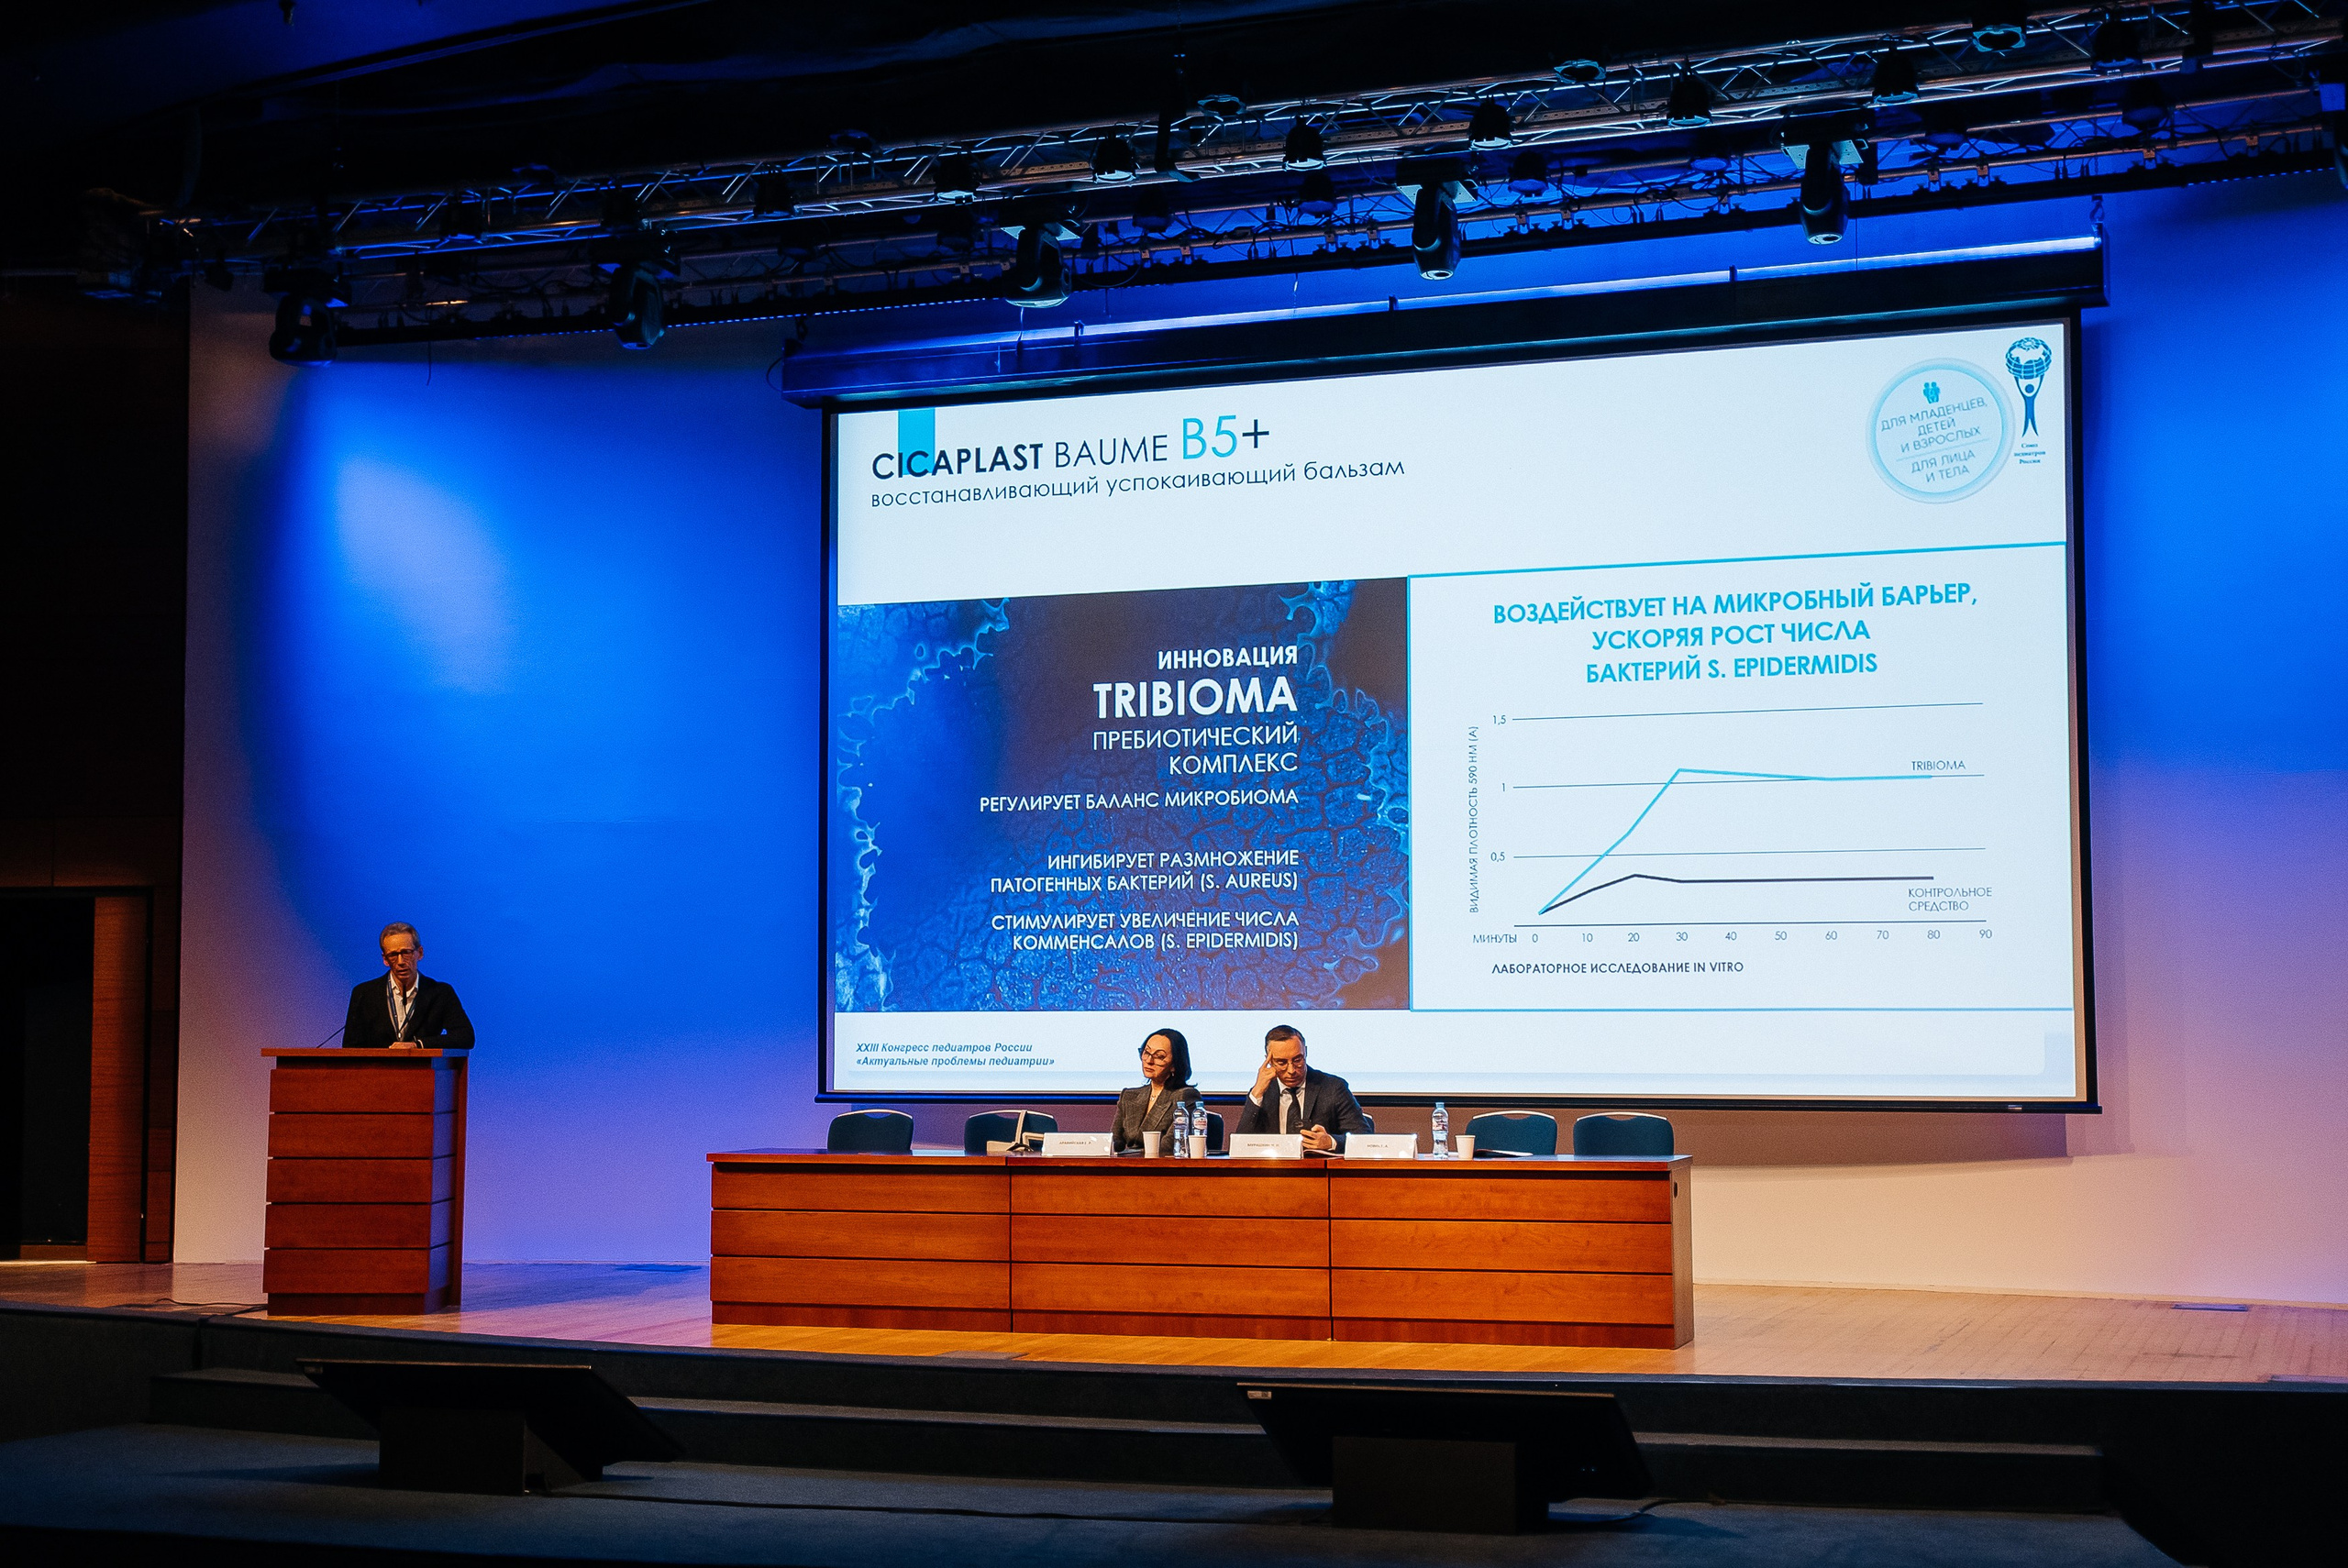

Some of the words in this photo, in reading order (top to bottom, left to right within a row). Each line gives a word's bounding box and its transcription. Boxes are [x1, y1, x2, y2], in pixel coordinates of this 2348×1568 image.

[1881, 415, 1907, 432] ДЛЯ
[1918, 418, 1956, 436] ДЕТЕЙ
[871, 444, 1043, 480] CICAPLAST
[1056, 435, 1167, 468] BAUME
[1183, 415, 1269, 459] B5+
[1901, 443, 1910, 453] И
[1914, 426, 1981, 450] ВЗРОСЛЫХ
[1911, 458, 1938, 473] ДЛЯ
[1942, 449, 1976, 468] ЛИЦА
[871, 476, 1100, 508] восстанавливающий
[1106, 463, 1296, 497] успокаивающий
[1303, 458, 1405, 480] бальзам
[1926, 472, 1935, 482] И
[1940, 465, 1970, 480] ТЕЛА
[1494, 596, 1666, 624] ВОЗДЕЙСТВУЕТ
[1673, 596, 1706, 615] НА
[1713, 582, 1873, 613] МИКРОБНЫЙ
[1882, 582, 1978, 609] БАРЬЕР,
[1592, 627, 1702, 650] УСКОРЯЯ
[1711, 624, 1775, 645] РОСТ
[1781, 620, 1870, 642] ЧИСЛА
[1159, 646, 1297, 669] ИННОВАЦИЯ
[1587, 655, 1700, 683] БАКТЕРИЙ
[1708, 659, 1725, 678] S.
[1734, 653, 1877, 677] EPIDERMIDIS
[1093, 677, 1297, 718] TRIBIOMA
[1493, 714, 1506, 724] 1,5
[1094, 721, 1297, 750] ПРЕБИОТИЧЕСКИЙ
[1170, 753, 1297, 774] КОМПЛЕКС
[1468, 745, 1477, 763] НМ
[1912, 760, 1966, 770] TRIBIOMA
[1468, 766, 1478, 784] 590
[1502, 783, 1505, 791] 1
[980, 795, 1080, 812] РЕГУЛИРУЕТ
[1087, 793, 1158, 809] БАЛАНС
[1165, 790, 1299, 806] МИКРОБИОМА
[1468, 788, 1478, 854] ПЛОТНОСТЬ
[1048, 853, 1155, 869] ИНГИБИРУЕТ
[1160, 850, 1299, 867] РАЗМНОЖЕНИЕ
[1490, 852, 1505, 862] 0,5
[991, 877, 1102, 892] ПАТОГЕННЫХ
[1108, 871, 1193, 890] БАКТЕРИЙ
[1202, 874, 1219, 892] (S.
[1227, 872, 1298, 891] AUREUS)
[1469, 858, 1479, 912] ВИДИМАЯ
[1909, 888, 1991, 898] КОНТРОЛЬНОЕ
[1909, 900, 1969, 911] СРЕДСТВО
[991, 913, 1115, 930] СТИМУЛИРУЕТ
[1121, 912, 1230, 928] УВЕЛИЧЕНИЕ
[1235, 911, 1299, 926] ЧИСЛА
[1013, 933, 1155, 950] КОММЕНСАЛОВ
[1162, 933, 1180, 951] (S.
[1187, 932, 1297, 950] EPIDERMIDIS)
[1473, 933, 1517, 943] МИНУТЫ
[1532, 933, 1538, 943] 0
[1582, 933, 1593, 943] 10
[1628, 933, 1640, 942] 20
[1677, 932, 1689, 941] 30
[1725, 932, 1737, 941] 40
[1775, 931, 1787, 941] 50
[1825, 931, 1837, 940] 60
[1877, 930, 1889, 940] 70
[1927, 930, 1940, 939] 80
[1979, 929, 1992, 939] 90
[1492, 963, 1586, 974] ЛАБОРАТОРНОЕ
[1590, 963, 1689, 974] ИССЛЕДОВАНИЕ
[1694, 963, 1705, 972] IN
[1710, 962, 1744, 972] VITRO
[857, 1043, 879, 1052] XXIII
[881, 1043, 929, 1054] Конгресс
[932, 1043, 991, 1054] педиатров
[994, 1043, 1033, 1052] России
[857, 1056, 928, 1067] «Актуальные
[932, 1056, 986, 1067] проблемы
[989, 1056, 1055, 1067] педиатрии»
